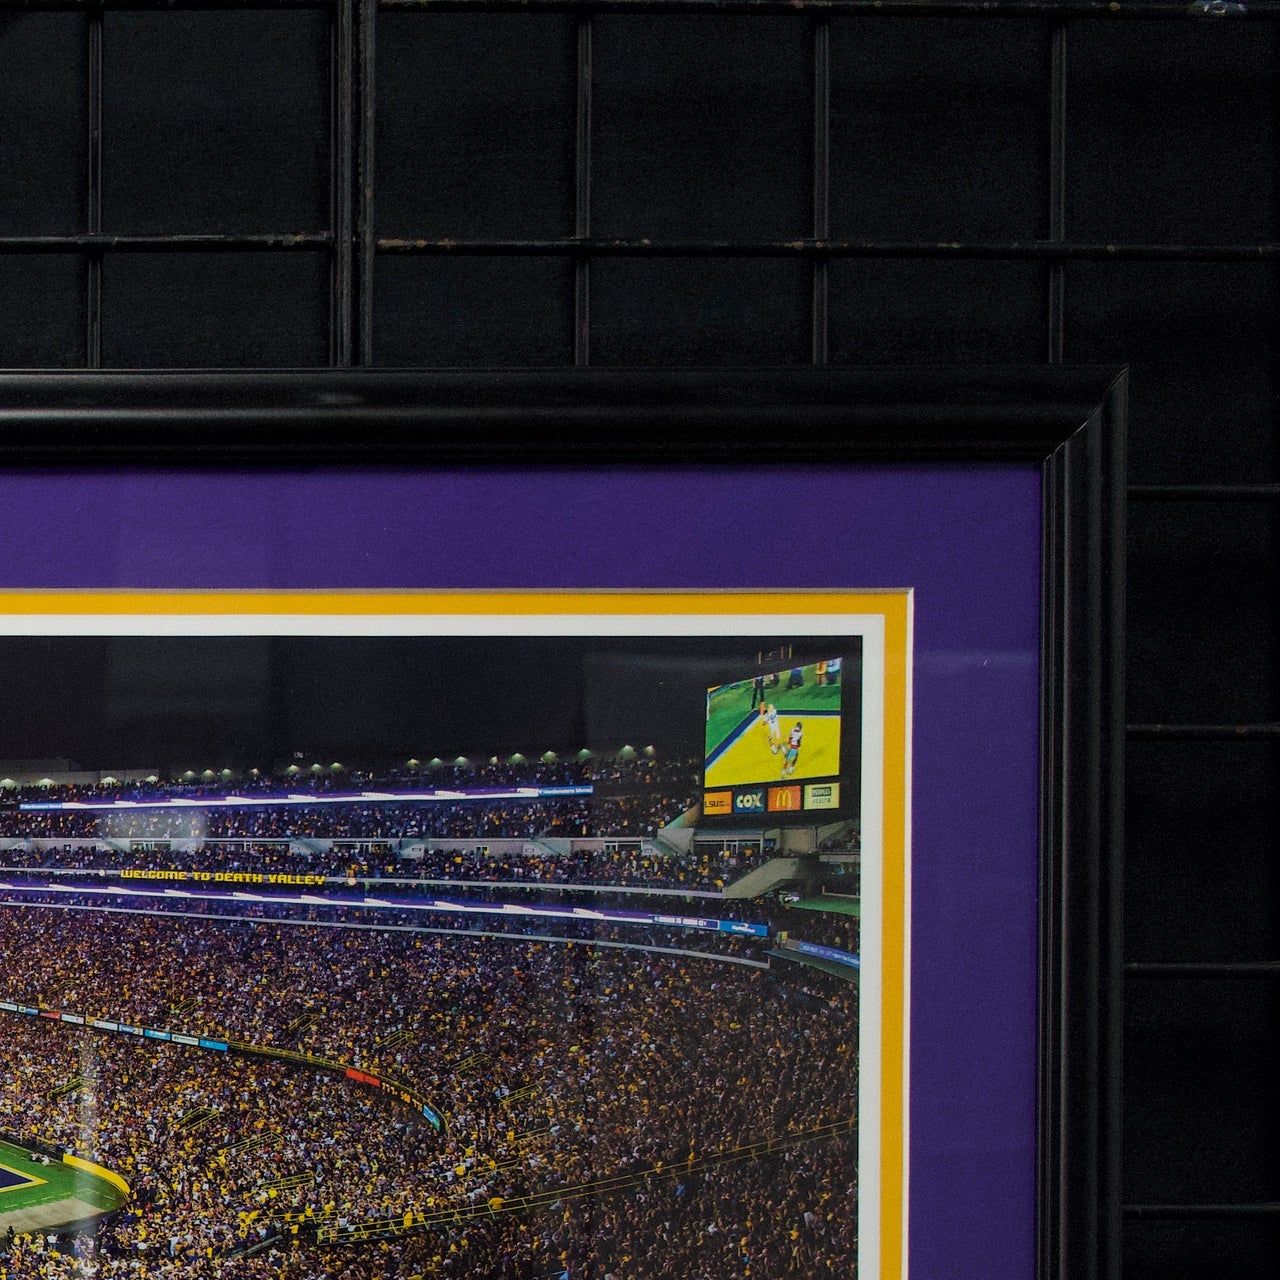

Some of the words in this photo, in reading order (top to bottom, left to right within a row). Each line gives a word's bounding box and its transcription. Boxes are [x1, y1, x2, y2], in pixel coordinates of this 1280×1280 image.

[736, 792, 763, 809] COX
[120, 869, 188, 880] WELCOME
[192, 871, 210, 881] TO
[215, 872, 263, 883] DEATH
[268, 874, 326, 885] VALLEY
